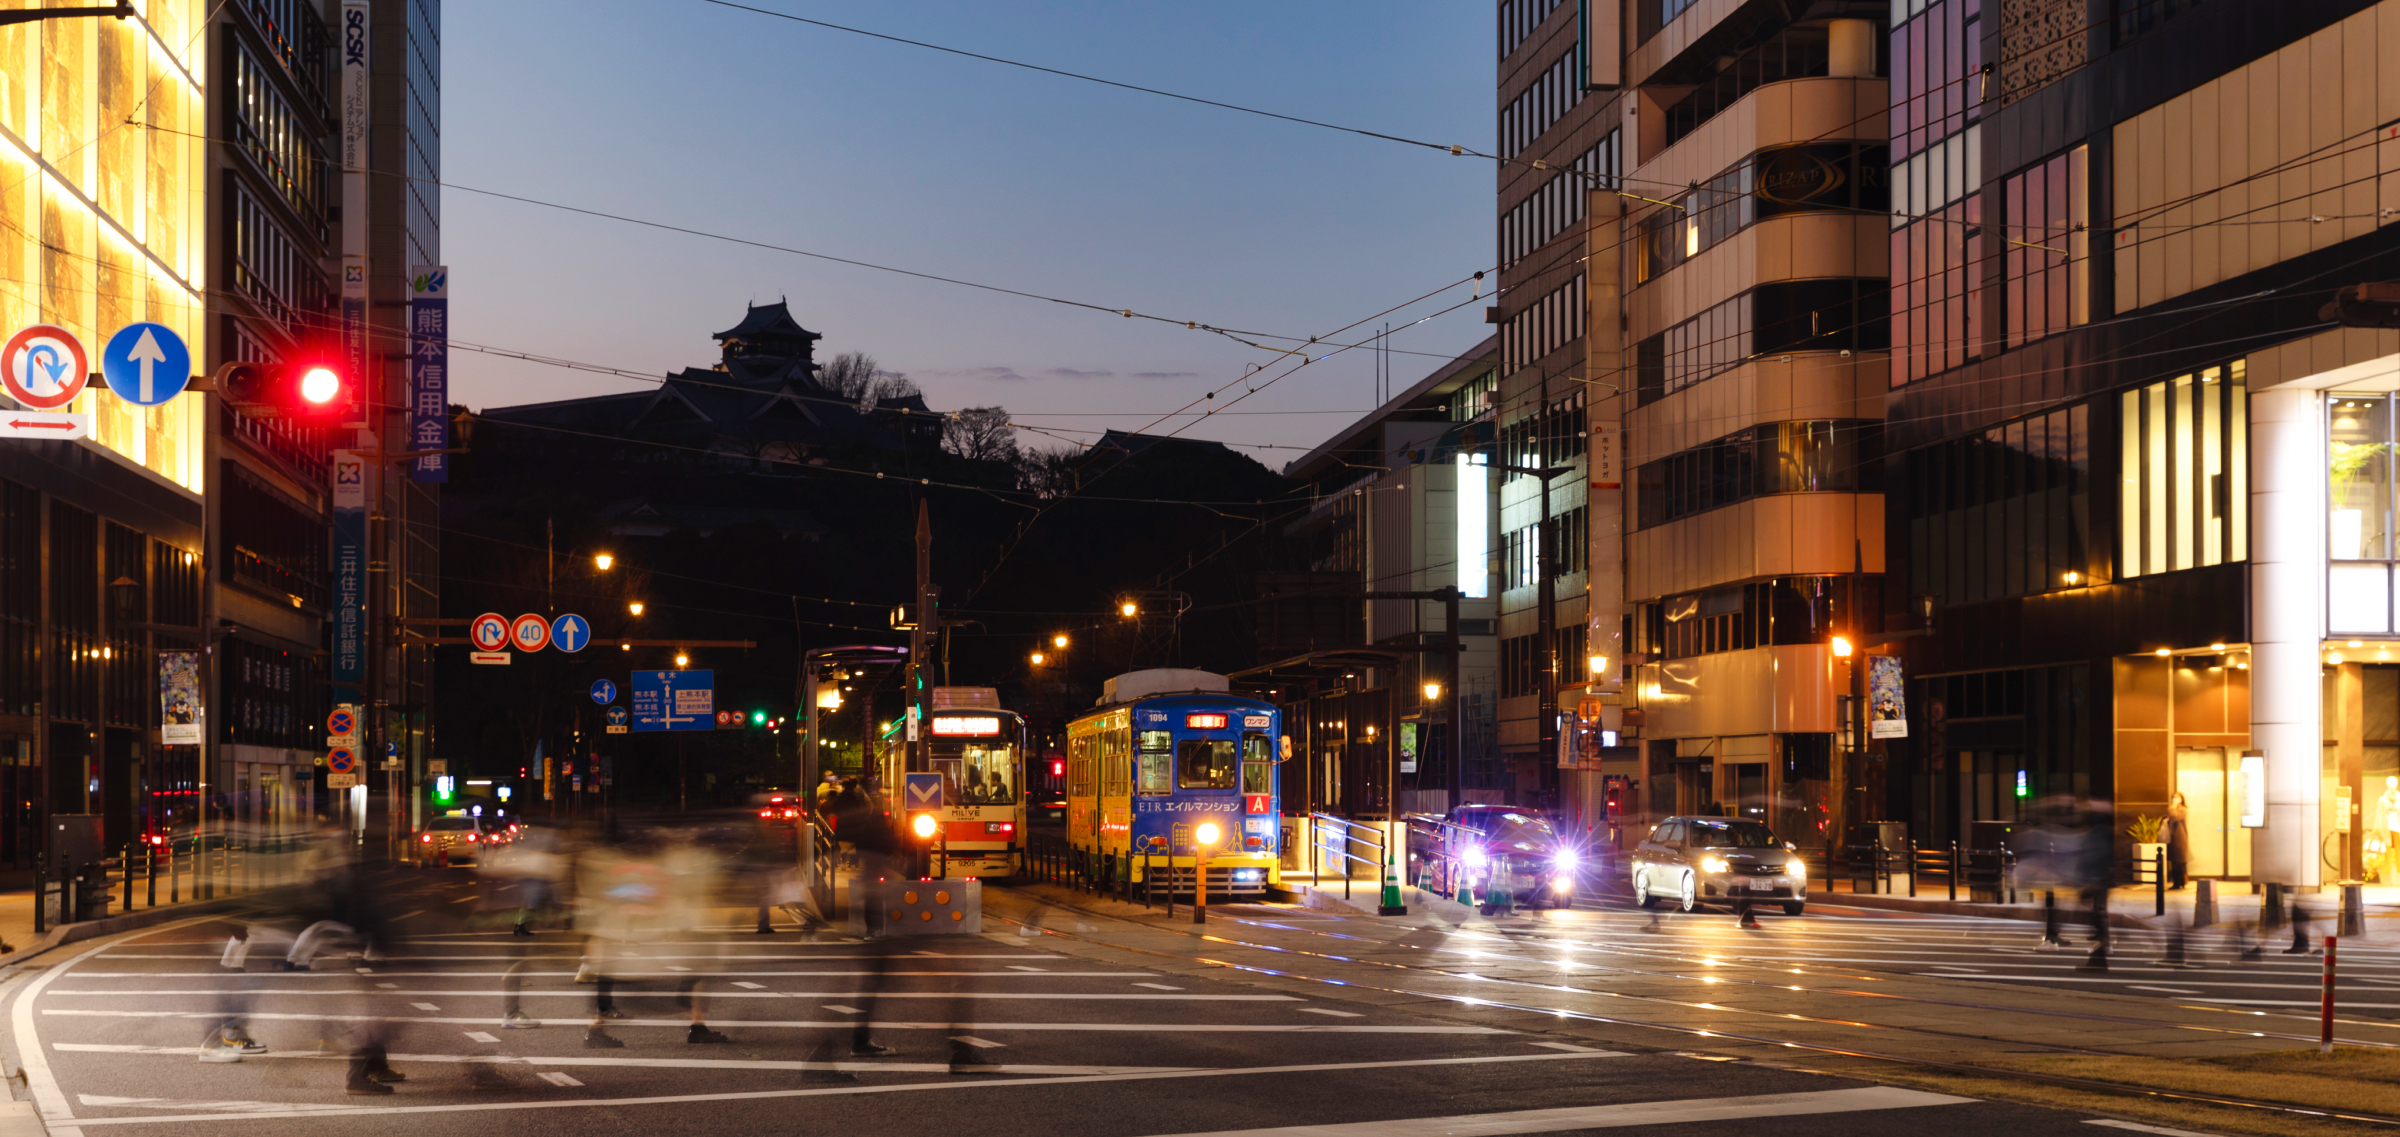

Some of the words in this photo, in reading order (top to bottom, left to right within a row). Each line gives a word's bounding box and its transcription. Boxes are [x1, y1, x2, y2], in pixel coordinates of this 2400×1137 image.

[346, 8, 364, 68] SCSK
[1768, 168, 1820, 186] RIZAP
[416, 307, 443, 472] 熊本信用金庫
[1602, 436, 1610, 479] ホットヨガ
[340, 545, 357, 670] 三井住友信託銀行
[520, 624, 541, 641] 40
[634, 690, 658, 698] 熊本駅
[679, 690, 709, 698] 上熊本駅
[635, 703, 659, 711] 熊本城
[1149, 713, 1168, 722] 1094
[1245, 718, 1269, 726] ワンマン
[1138, 801, 1163, 812] EIR
[1165, 801, 1240, 812] エイルマンション
[1252, 796, 1264, 812] A
[952, 808, 981, 817] MILIVE
[958, 859, 976, 867] 9205
